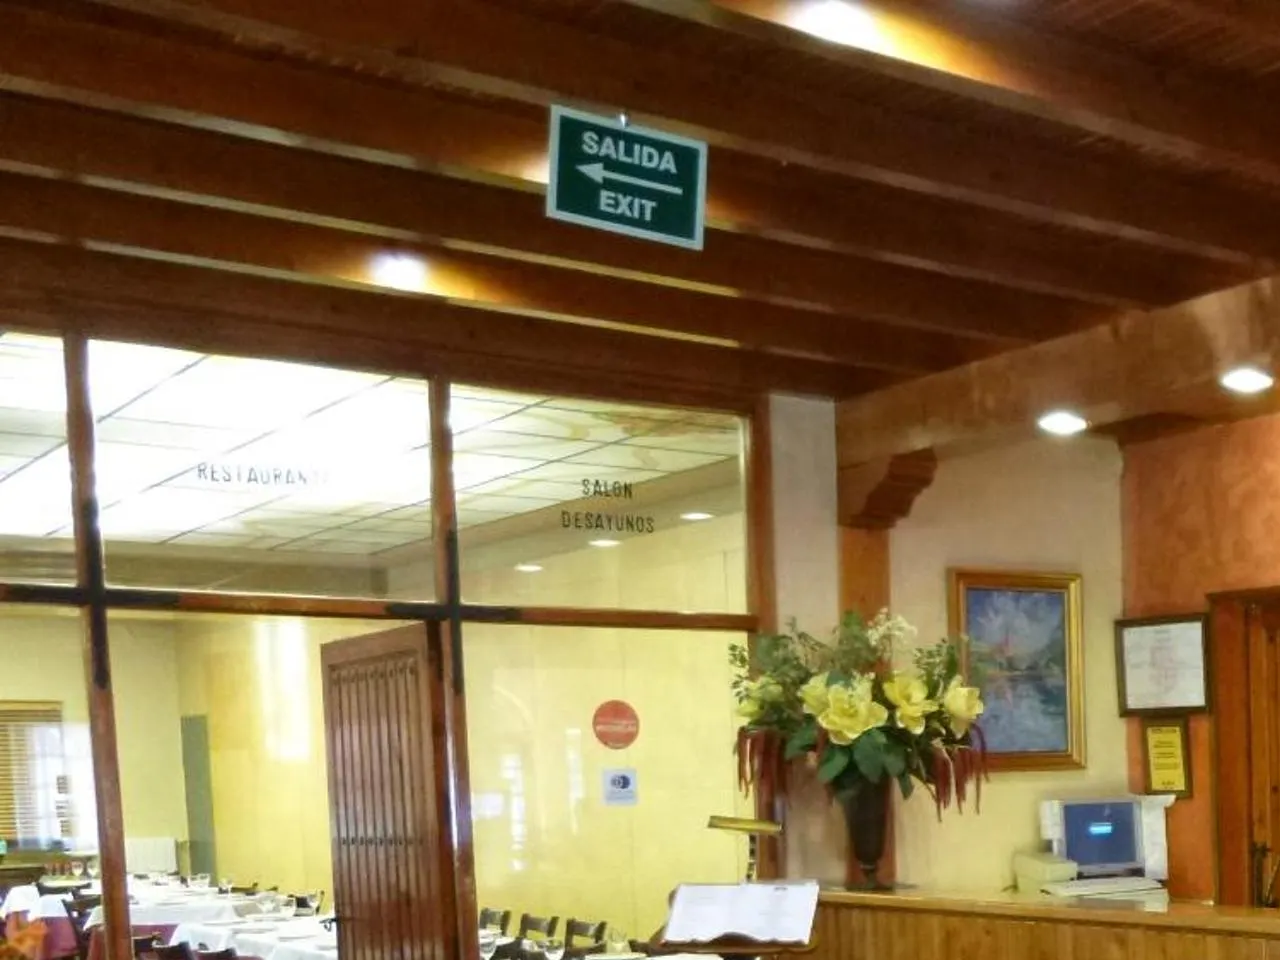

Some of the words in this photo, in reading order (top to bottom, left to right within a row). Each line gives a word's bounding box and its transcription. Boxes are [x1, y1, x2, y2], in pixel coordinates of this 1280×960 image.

[581, 131, 677, 174] SALIDA
[599, 189, 657, 221] EXIT
[197, 461, 330, 485] RESTAURAN
[561, 510, 654, 533] DESAYUNOS
